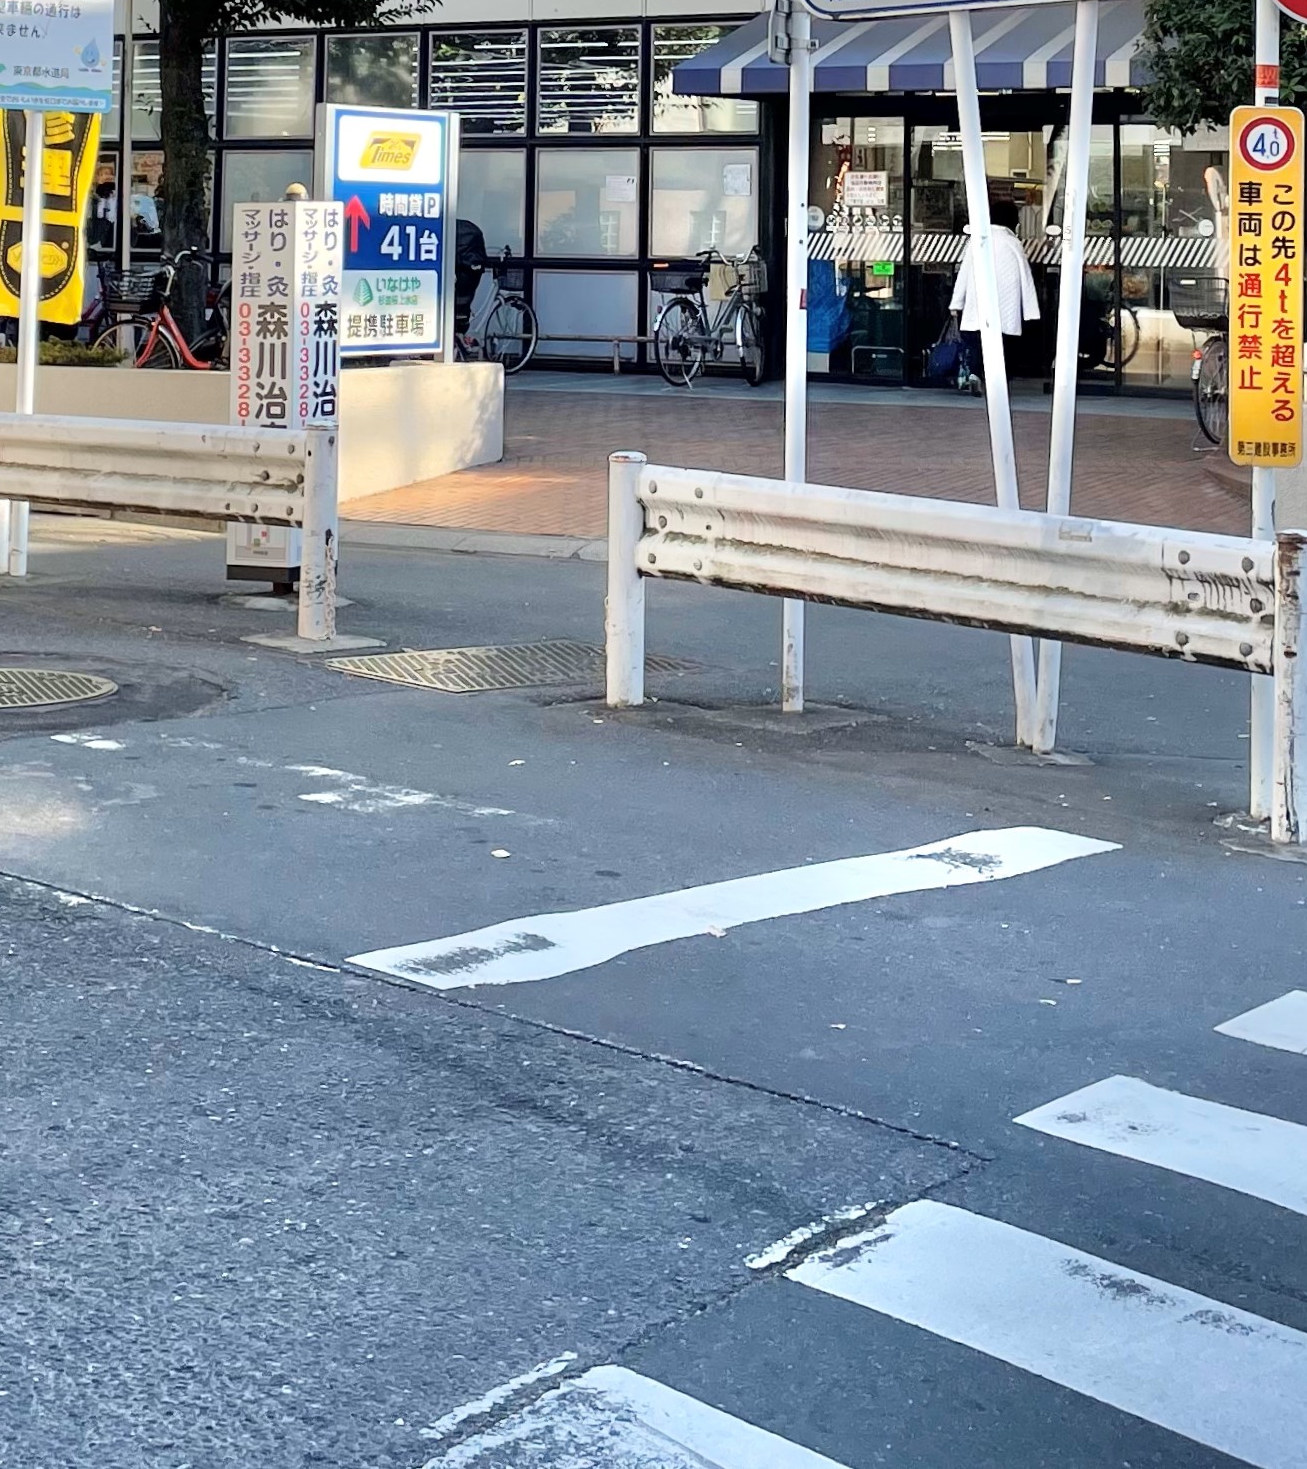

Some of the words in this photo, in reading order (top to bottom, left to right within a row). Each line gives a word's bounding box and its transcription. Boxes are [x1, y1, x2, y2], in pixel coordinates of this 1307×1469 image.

[13, 65, 70, 79] 東京都水道局
[371, 138, 415, 165] Times
[380, 225, 439, 262] 41台
[1237, 181, 1263, 391] 車両は通行禁止
[1270, 183, 1296, 423] この先4tを超える
[347, 314, 425, 338] 提携駐車場
[255, 301, 289, 428] 森川治
